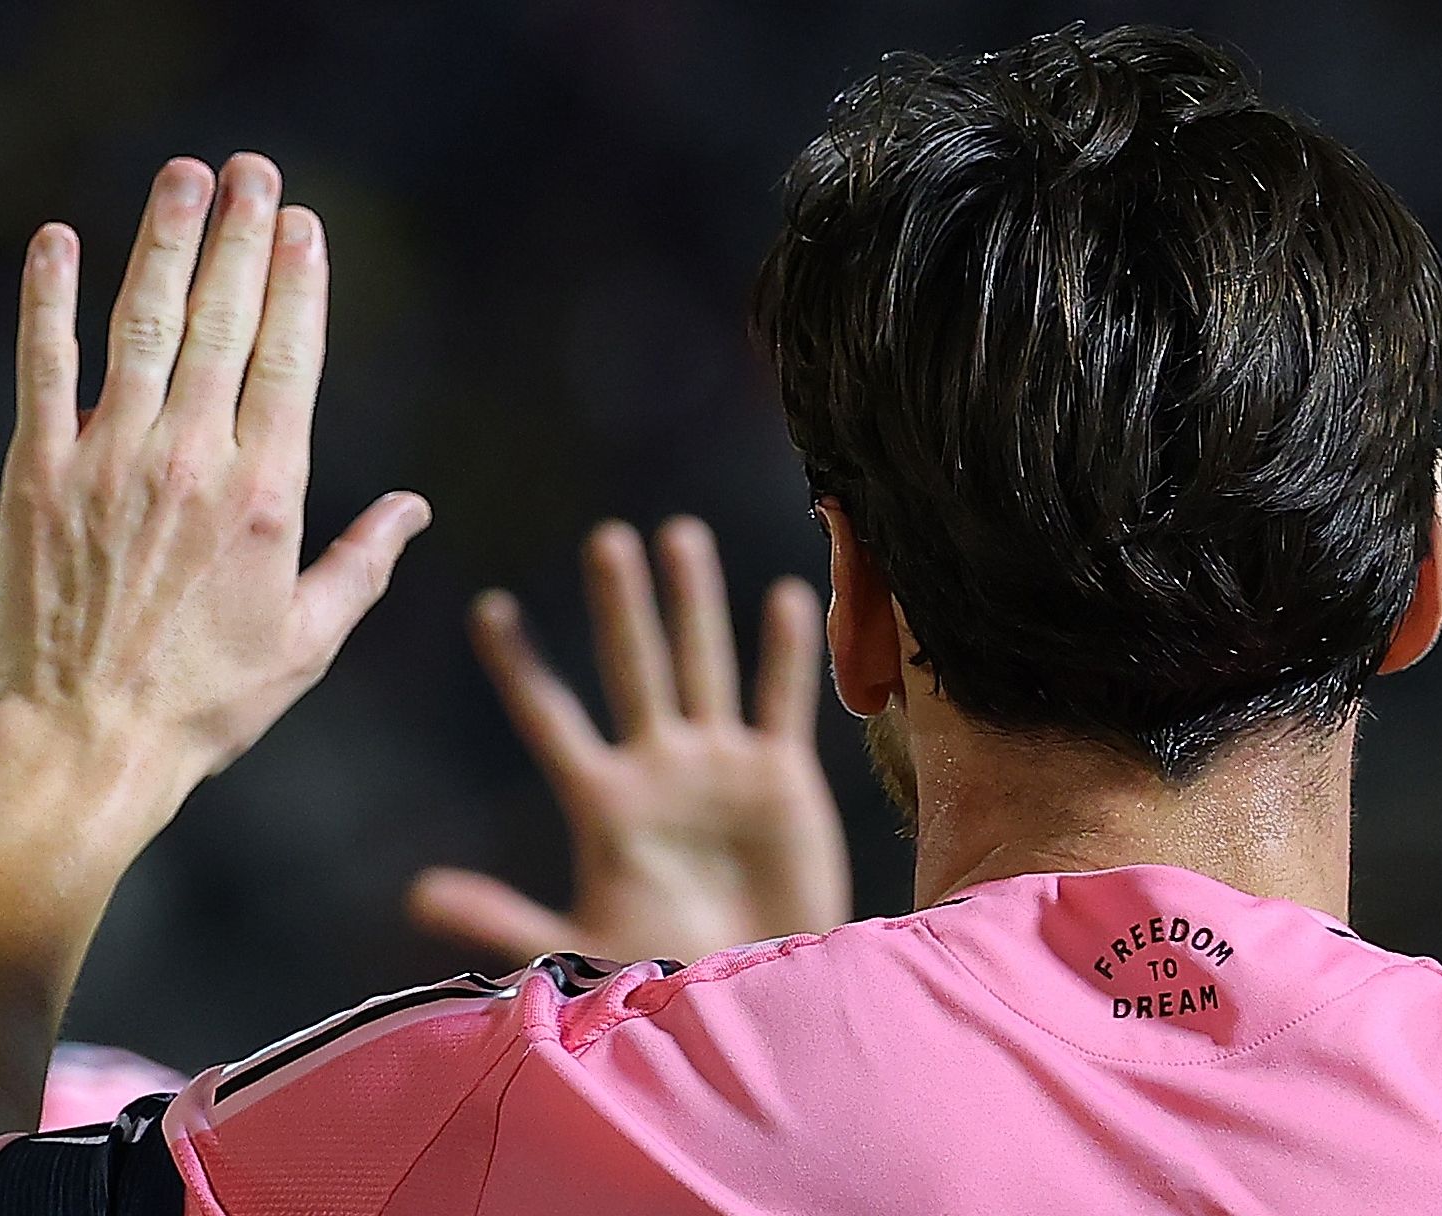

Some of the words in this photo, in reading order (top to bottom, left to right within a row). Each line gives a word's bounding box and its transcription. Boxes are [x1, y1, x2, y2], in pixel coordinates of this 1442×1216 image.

[1094, 917, 1234, 980] FREEDOM
[1148, 958, 1178, 981] TO
[1113, 984, 1219, 1019] DREAM
